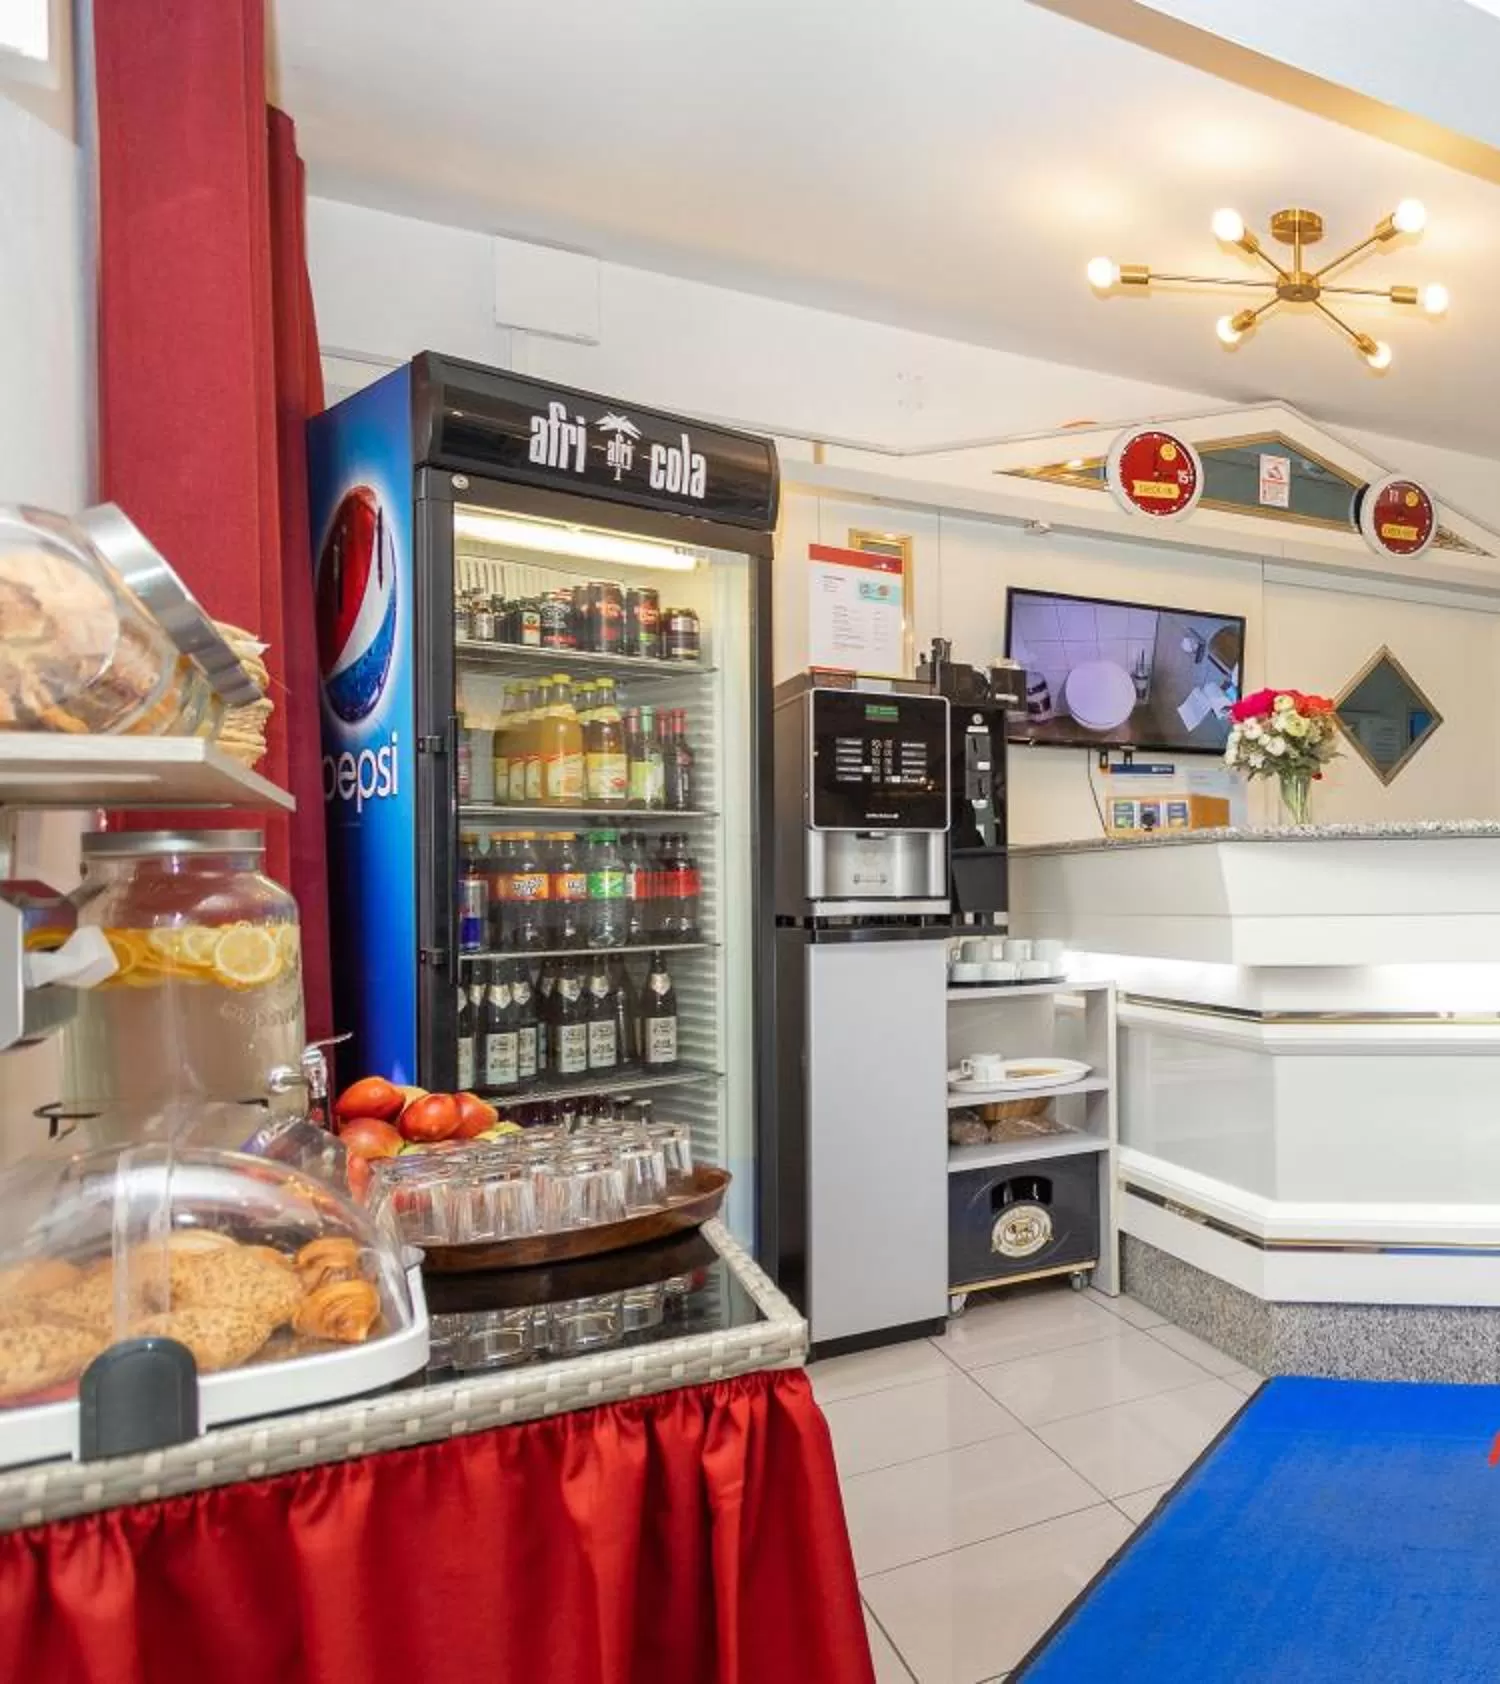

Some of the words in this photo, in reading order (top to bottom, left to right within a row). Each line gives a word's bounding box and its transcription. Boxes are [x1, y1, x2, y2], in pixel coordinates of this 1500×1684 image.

[529, 401, 587, 473] afri
[650, 433, 707, 499] cola
[322, 731, 398, 813] pepsi
